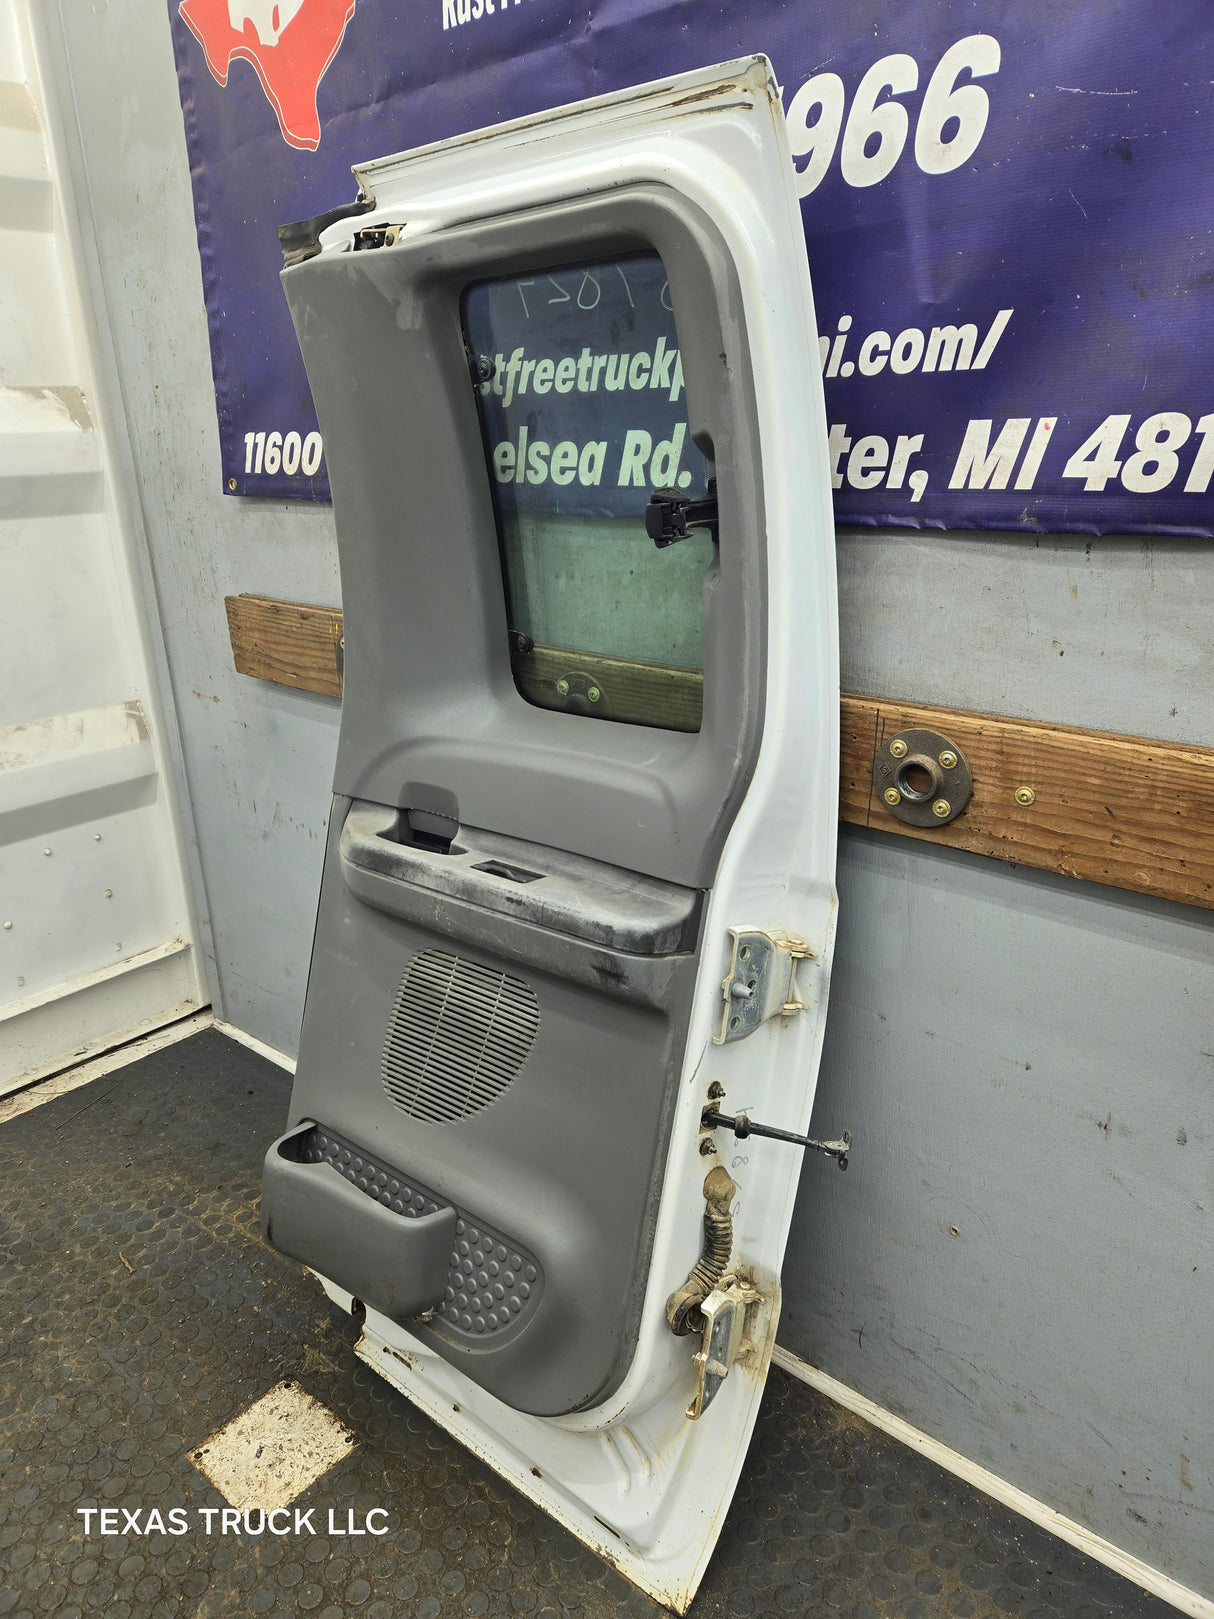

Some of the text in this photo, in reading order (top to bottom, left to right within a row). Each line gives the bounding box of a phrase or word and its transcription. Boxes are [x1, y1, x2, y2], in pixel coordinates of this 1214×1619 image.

[778, 34, 1001, 199] 966
[244, 431, 323, 476] 11600
[617, 423, 692, 488] Rd.
[948, 417, 1058, 490] MI
